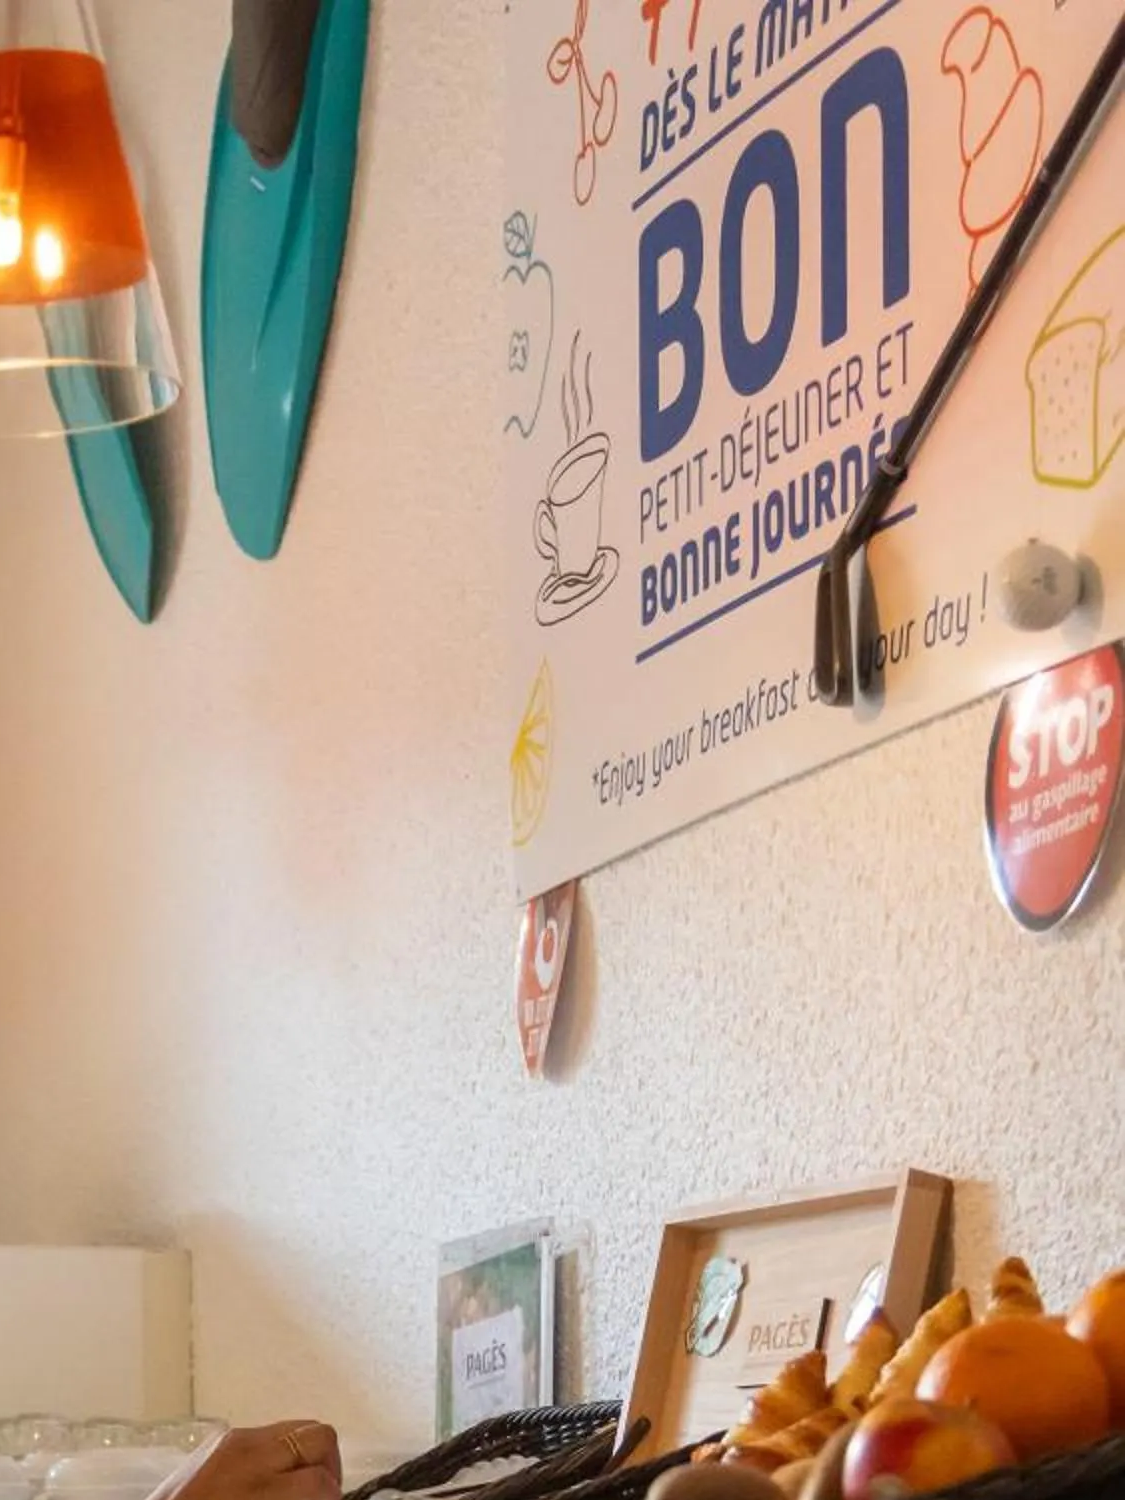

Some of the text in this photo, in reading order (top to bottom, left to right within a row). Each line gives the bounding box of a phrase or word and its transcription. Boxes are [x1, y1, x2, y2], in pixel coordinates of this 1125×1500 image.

[640, 66, 698, 172] DÈS
[708, 23, 745, 113] LE
[638, 45, 910, 464] BON
[640, 320, 915, 545] PETIT-DÉJEUNER ET
[642, 511, 741, 627] BONNE
[652, 721, 695, 787] your
[699, 667, 800, 755] breakfast
[923, 591, 972, 648] day
[1007, 683, 1115, 790] STOP
[1008, 763, 1108, 824] au gaspillage
